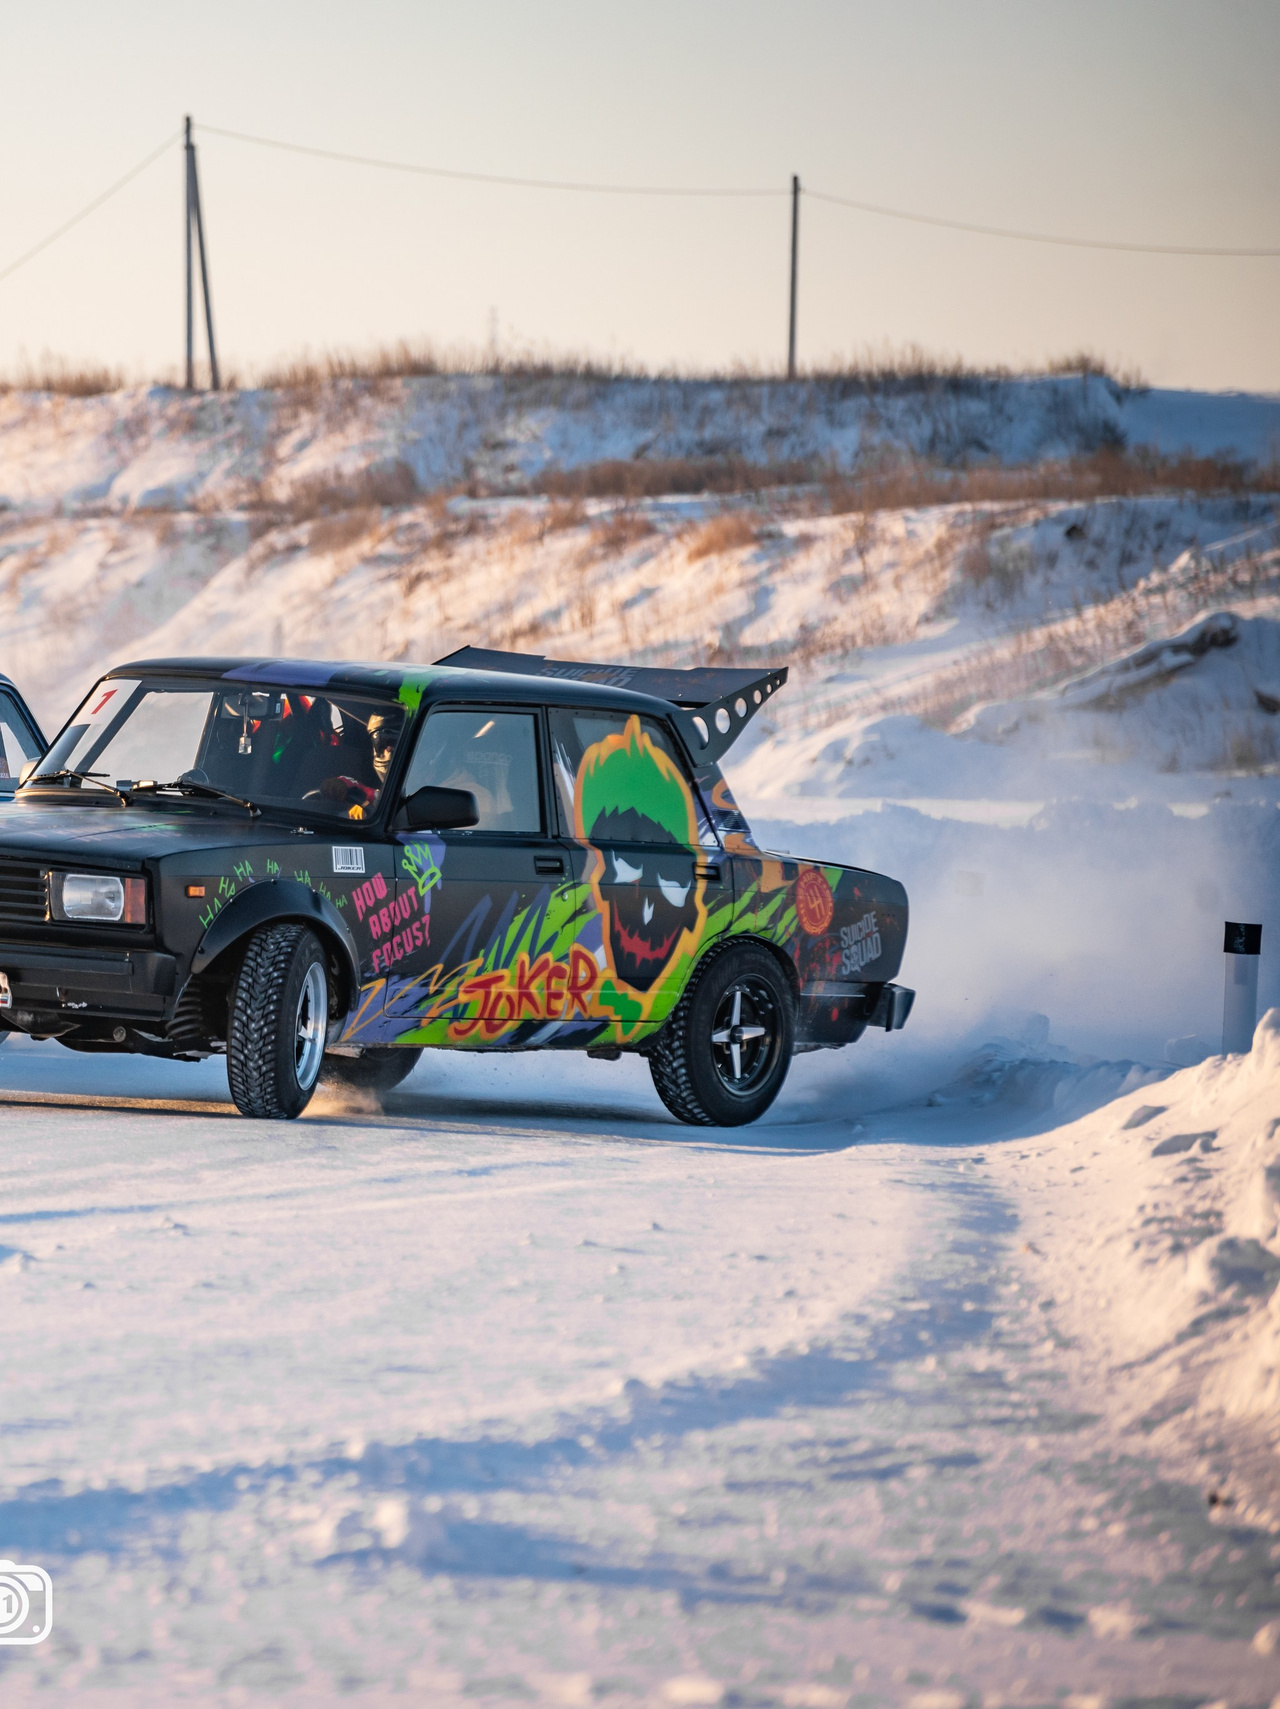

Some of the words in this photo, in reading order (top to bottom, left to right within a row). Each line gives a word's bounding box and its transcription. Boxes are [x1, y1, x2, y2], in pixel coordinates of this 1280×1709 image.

[90, 688, 118, 715] 1
[352, 872, 387, 922] HOW
[368, 886, 418, 940] ABOUT
[372, 914, 431, 974] FOCUS?
[840, 911, 879, 948] SUICIDE
[841, 932, 882, 975] SQUAD
[451, 947, 599, 1038] JOKER
